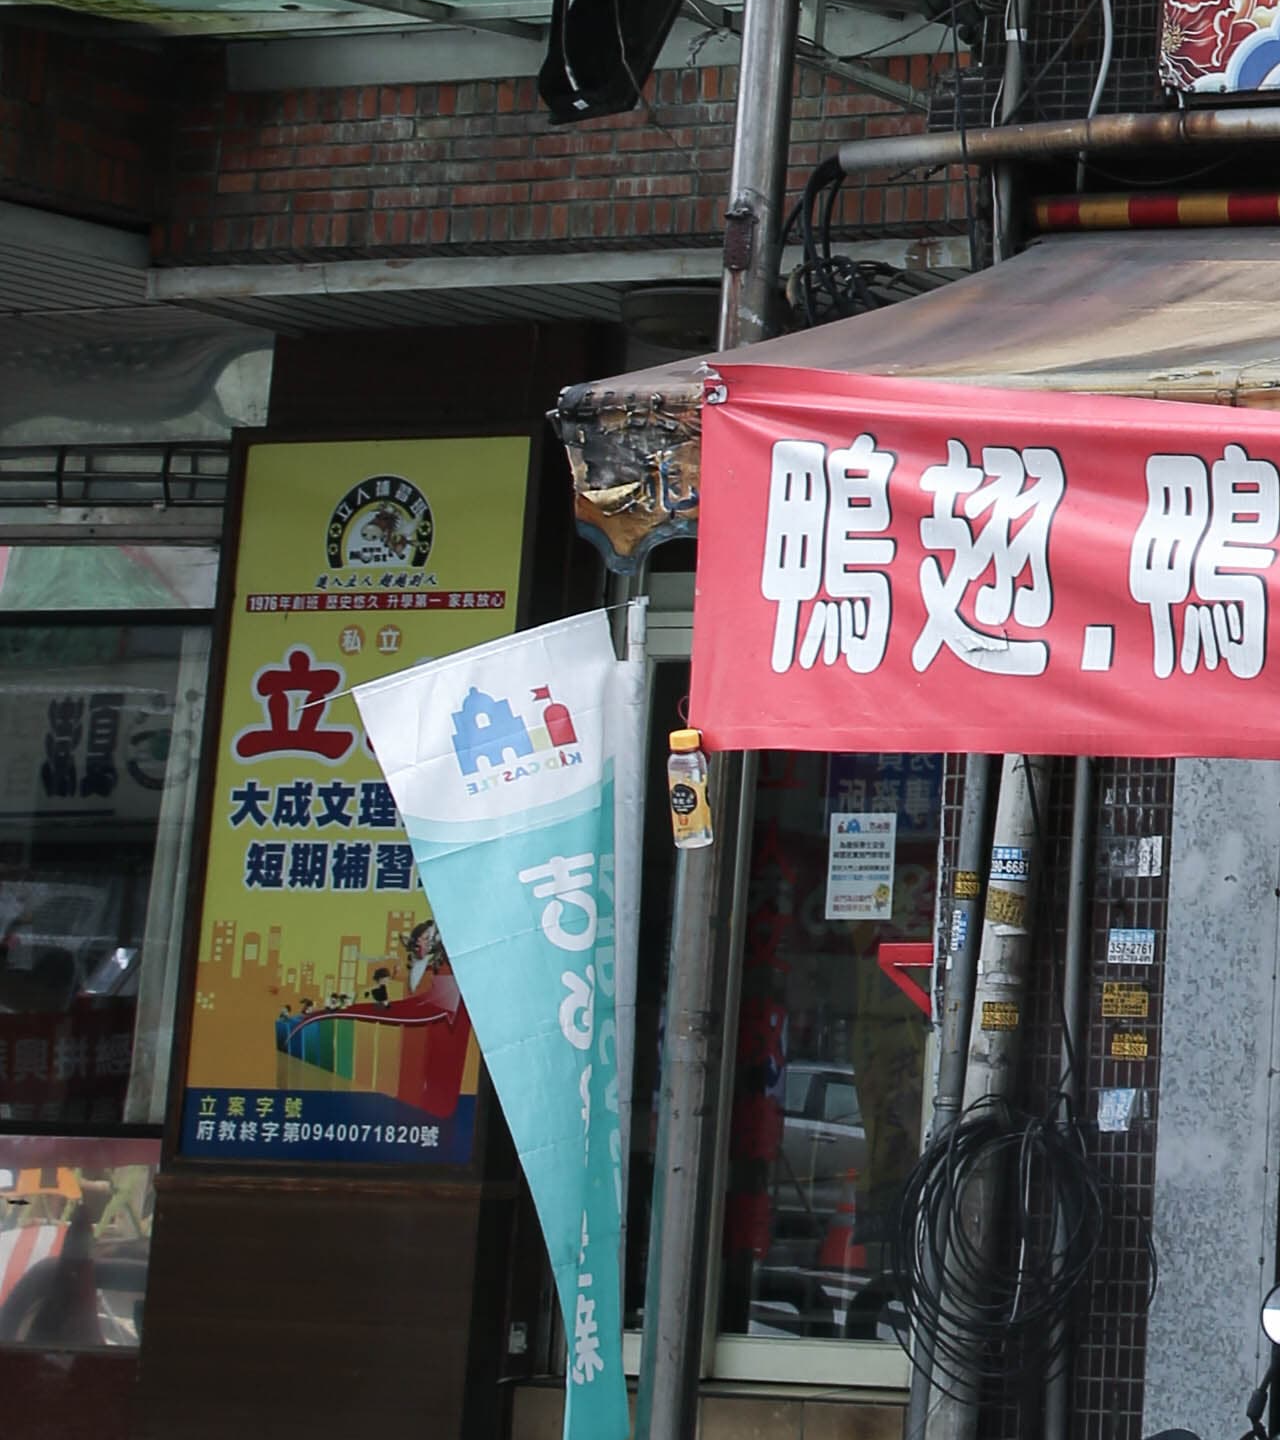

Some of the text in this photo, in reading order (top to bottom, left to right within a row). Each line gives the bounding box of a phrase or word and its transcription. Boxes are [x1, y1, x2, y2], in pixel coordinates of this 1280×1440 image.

[386, 593, 441, 609] 升學第一
[448, 592, 504, 608] 家長放心
[341, 628, 401, 653] 私立
[236, 650, 376, 760] 立
[231, 781, 407, 828] 大成文理
[246, 843, 424, 889] 短期補習
[198, 1096, 303, 1118] 立案字號
